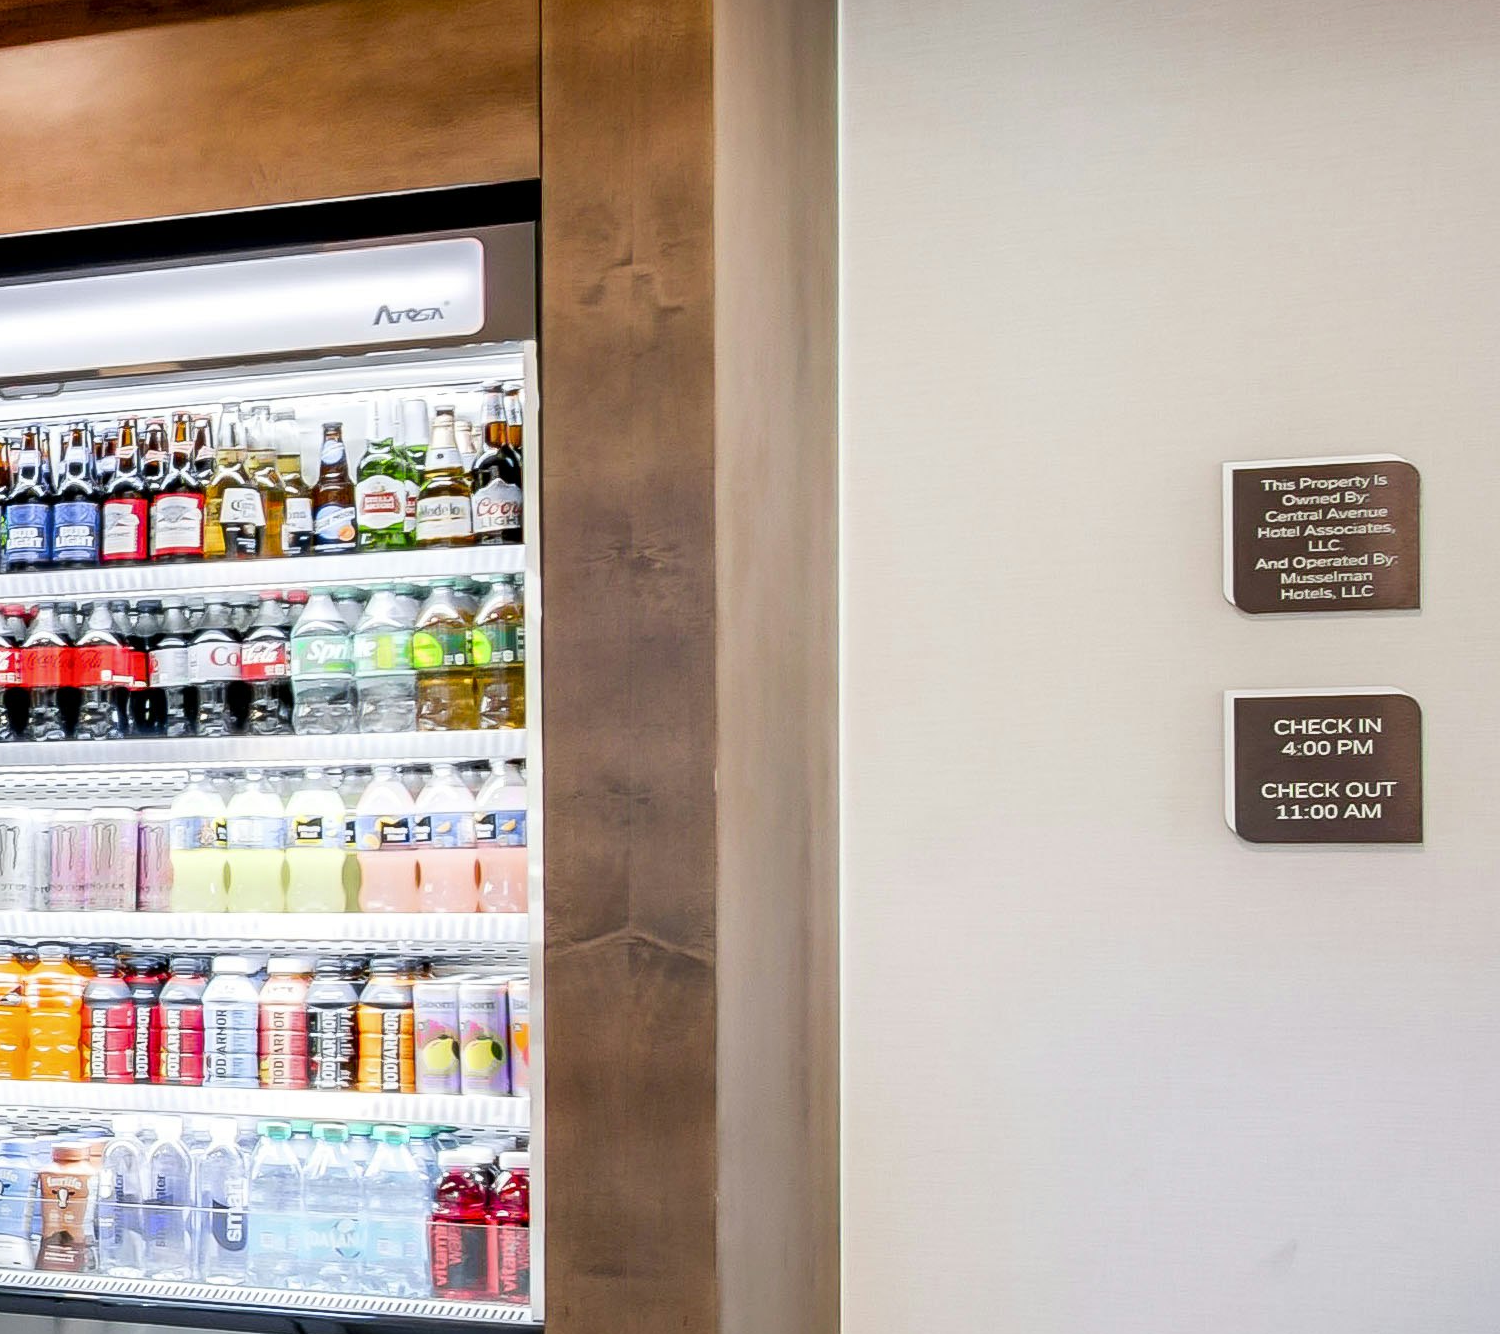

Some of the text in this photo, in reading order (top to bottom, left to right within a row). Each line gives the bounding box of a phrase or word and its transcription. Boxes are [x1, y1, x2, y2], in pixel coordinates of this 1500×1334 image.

[1261, 474, 1388, 491] This Property Is
[1282, 492, 1340, 506] Owned
[1265, 508, 1388, 523] Central Avenue
[1257, 522, 1396, 539] Hotel Associates,
[1254, 557, 1289, 571] And
[1292, 553, 1368, 569] Operated
[1280, 571, 1373, 585] Musselman
[1281, 585, 1375, 601] Hotels, LLC
[211, 646, 241, 667] Co
[307, 640, 349, 663] Spri
[1274, 717, 1382, 735] CHECK IN
[1281, 739, 1373, 756] 4:00 PM
[1261, 781, 1399, 799] CHECK OUT
[1275, 803, 1382, 820] 11:00 AM
